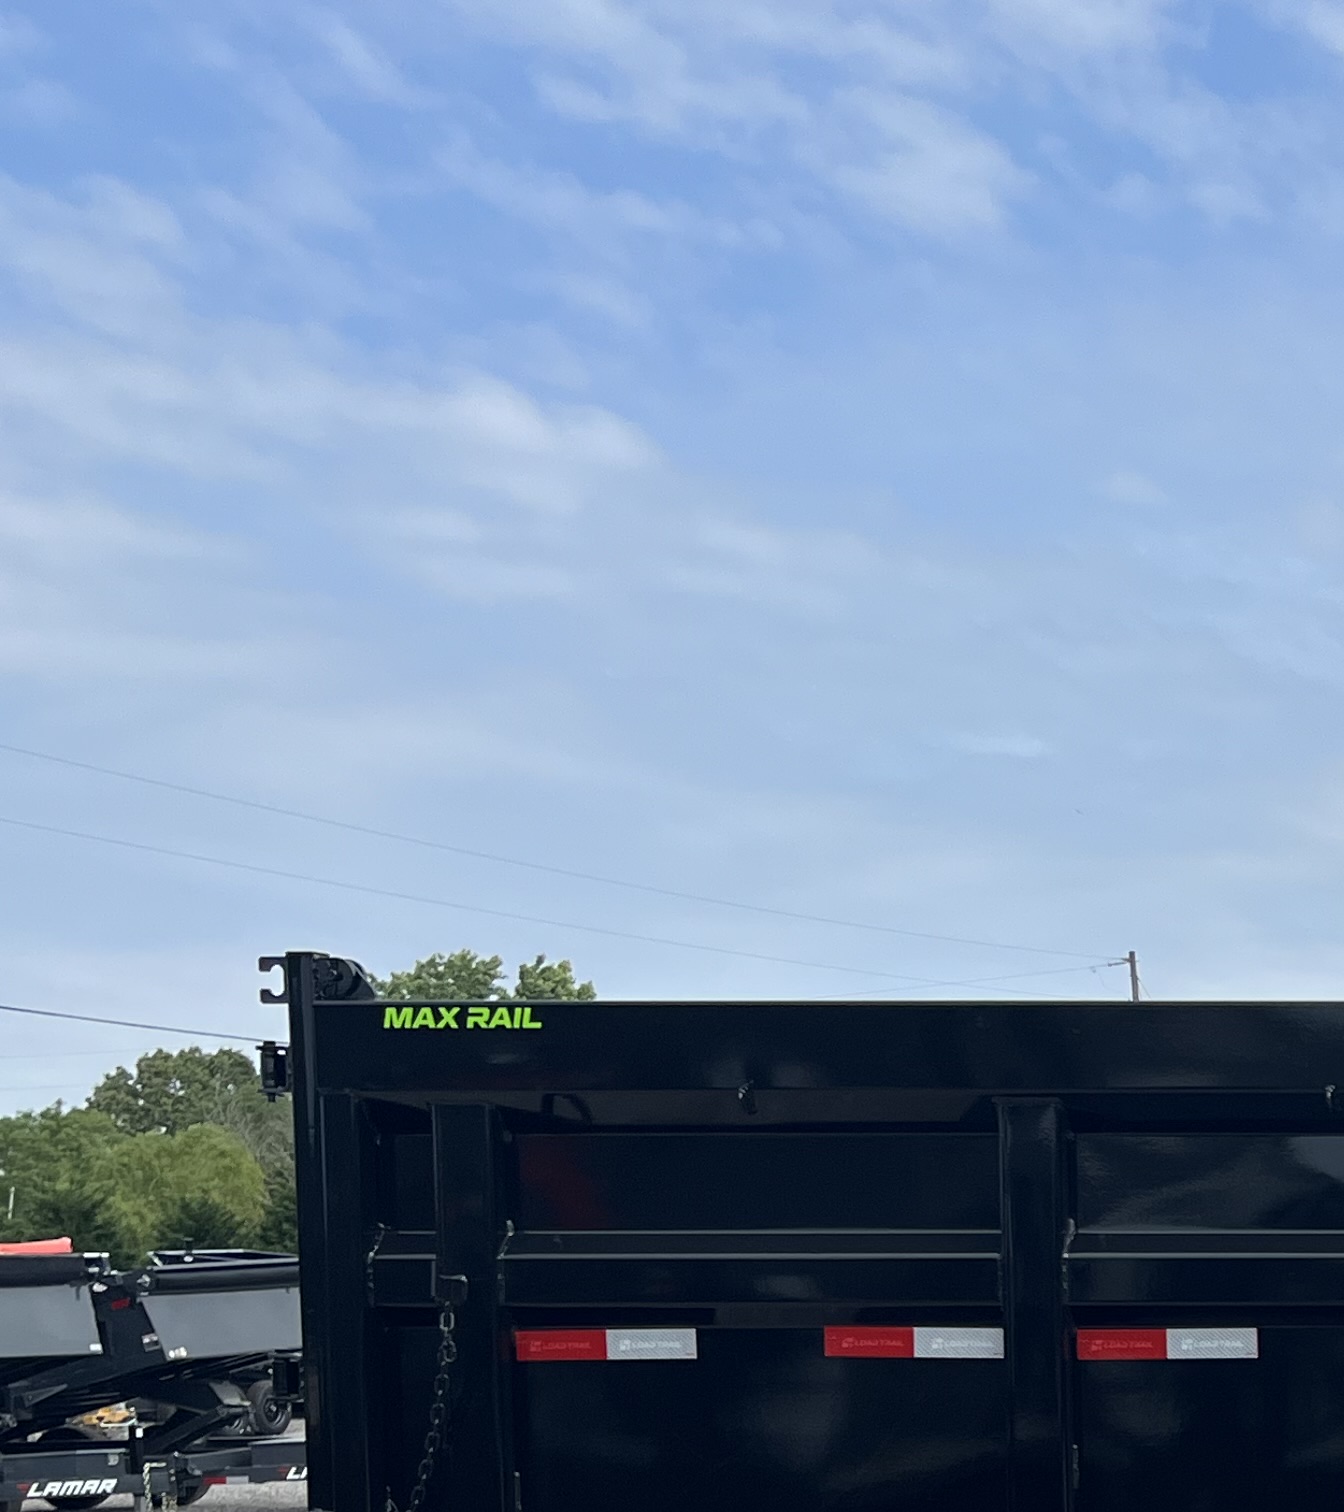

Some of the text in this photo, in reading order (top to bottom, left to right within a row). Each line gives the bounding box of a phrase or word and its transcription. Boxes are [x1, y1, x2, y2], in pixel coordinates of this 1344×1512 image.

[383, 1006, 542, 1029] MAX RAIL
[27, 1478, 117, 1498] LAMAR
